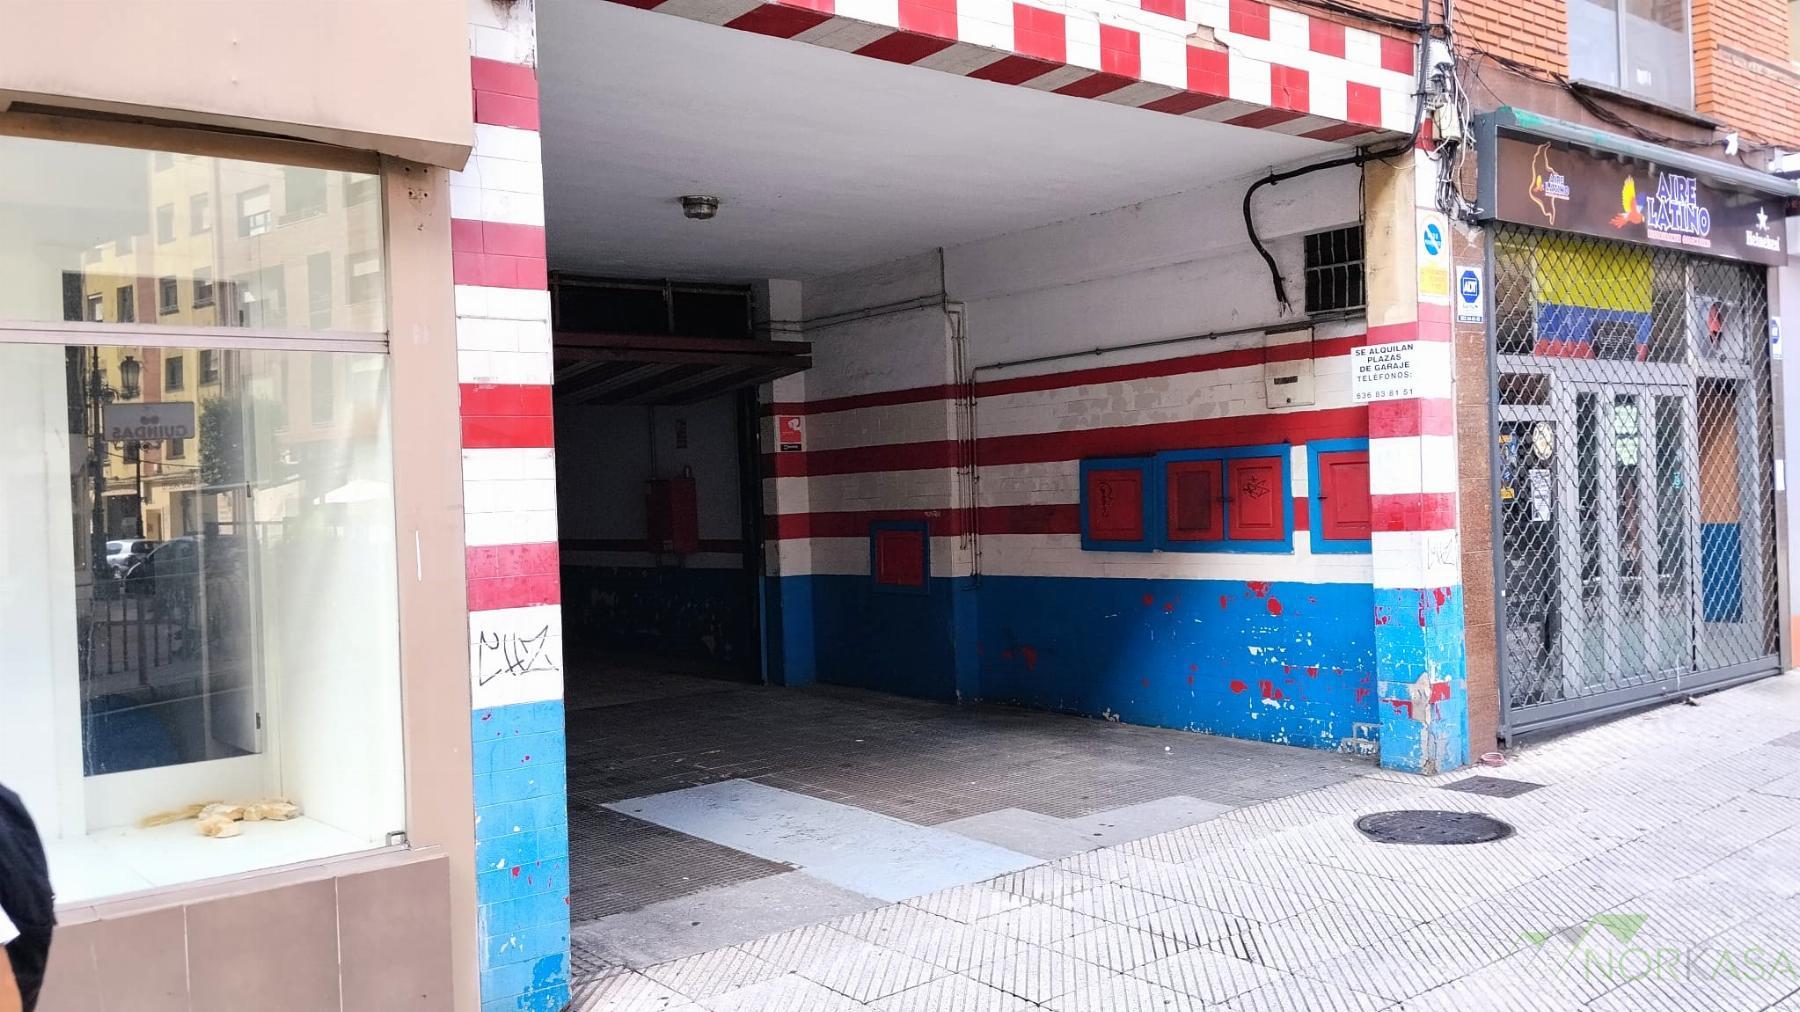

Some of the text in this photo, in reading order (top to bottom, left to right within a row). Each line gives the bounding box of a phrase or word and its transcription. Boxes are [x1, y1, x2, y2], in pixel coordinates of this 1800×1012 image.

[1655, 171, 1697, 207] AIRE
[1646, 196, 1711, 236] LATINO
[1355, 344, 1414, 356] SE ALQUILAN
[1367, 353, 1402, 363] PLAZAS
[1359, 361, 1411, 373] DE GARAJE
[1403, 388, 1413, 396] 51
